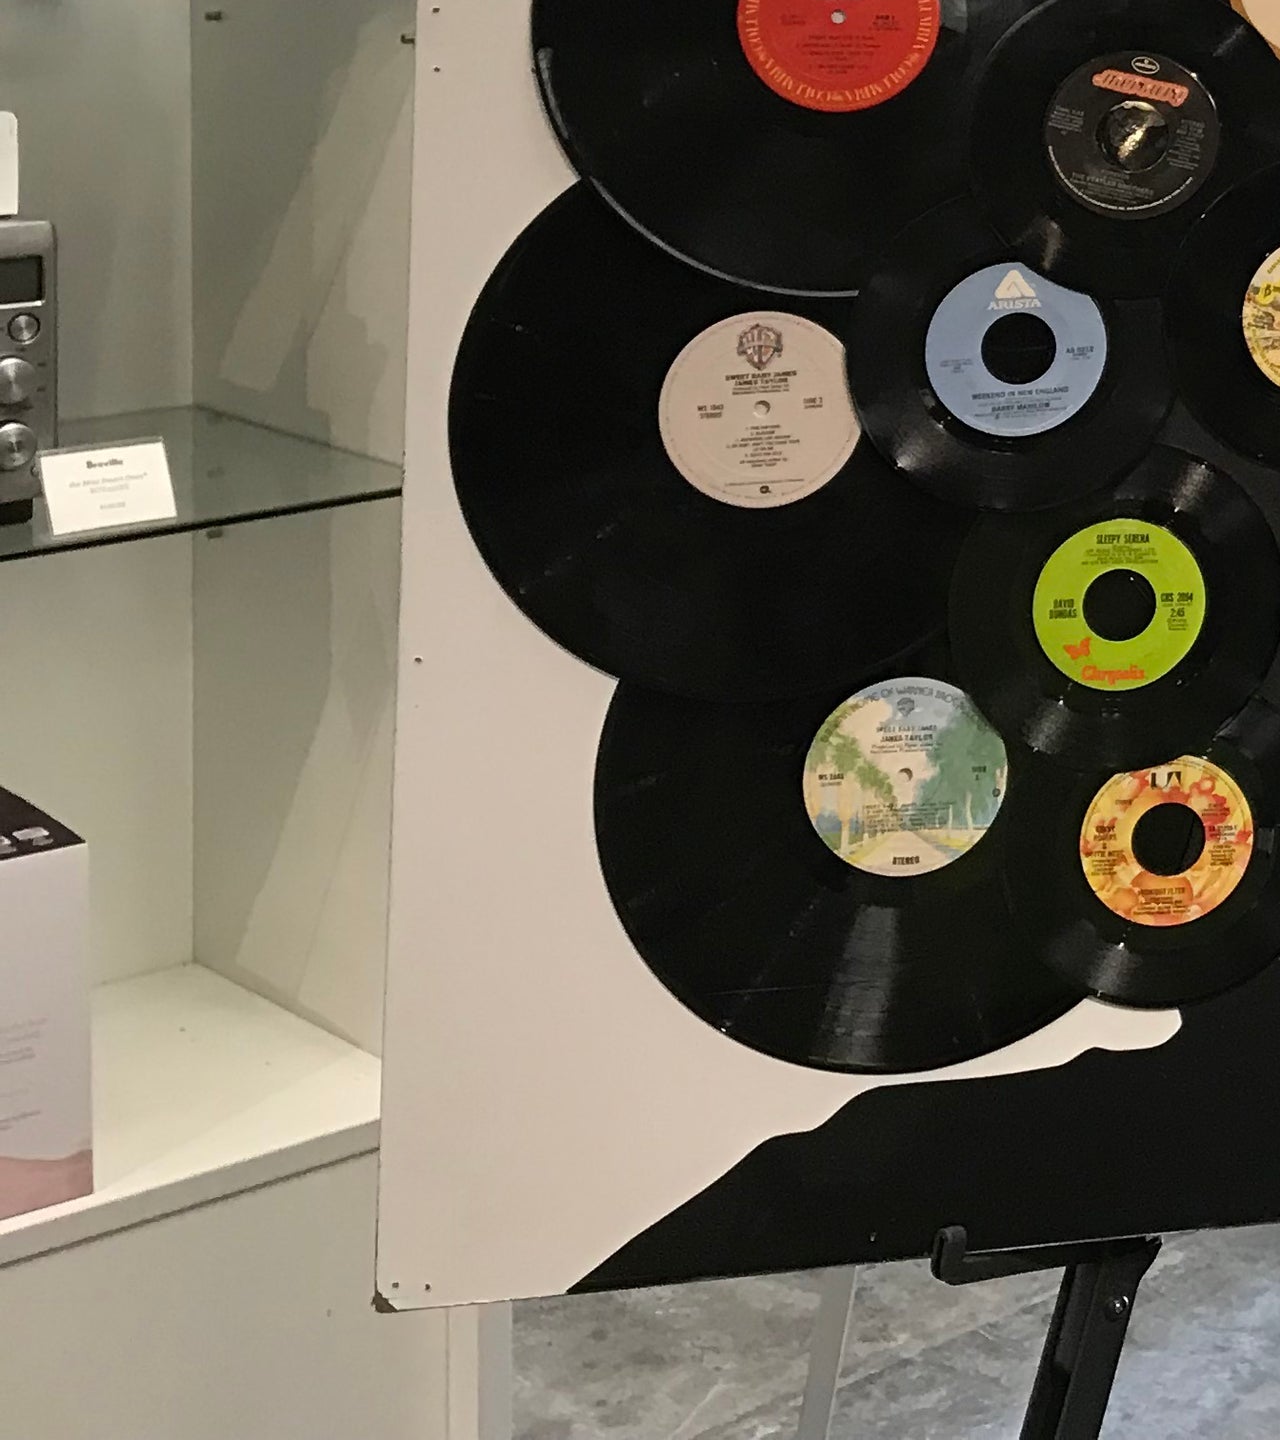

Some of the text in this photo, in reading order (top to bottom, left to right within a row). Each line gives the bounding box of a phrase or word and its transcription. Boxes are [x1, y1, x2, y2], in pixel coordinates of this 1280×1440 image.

[987, 298, 1041, 310] ARISTA
[972, 392, 1006, 400] WEEKEND
[1035, 386, 1069, 395] ENGLAND
[1096, 533, 1150, 545] SLEEPY SERENA
[1053, 599, 1075, 609] DAVID
[1081, 664, 1145, 686] Chrysalis
